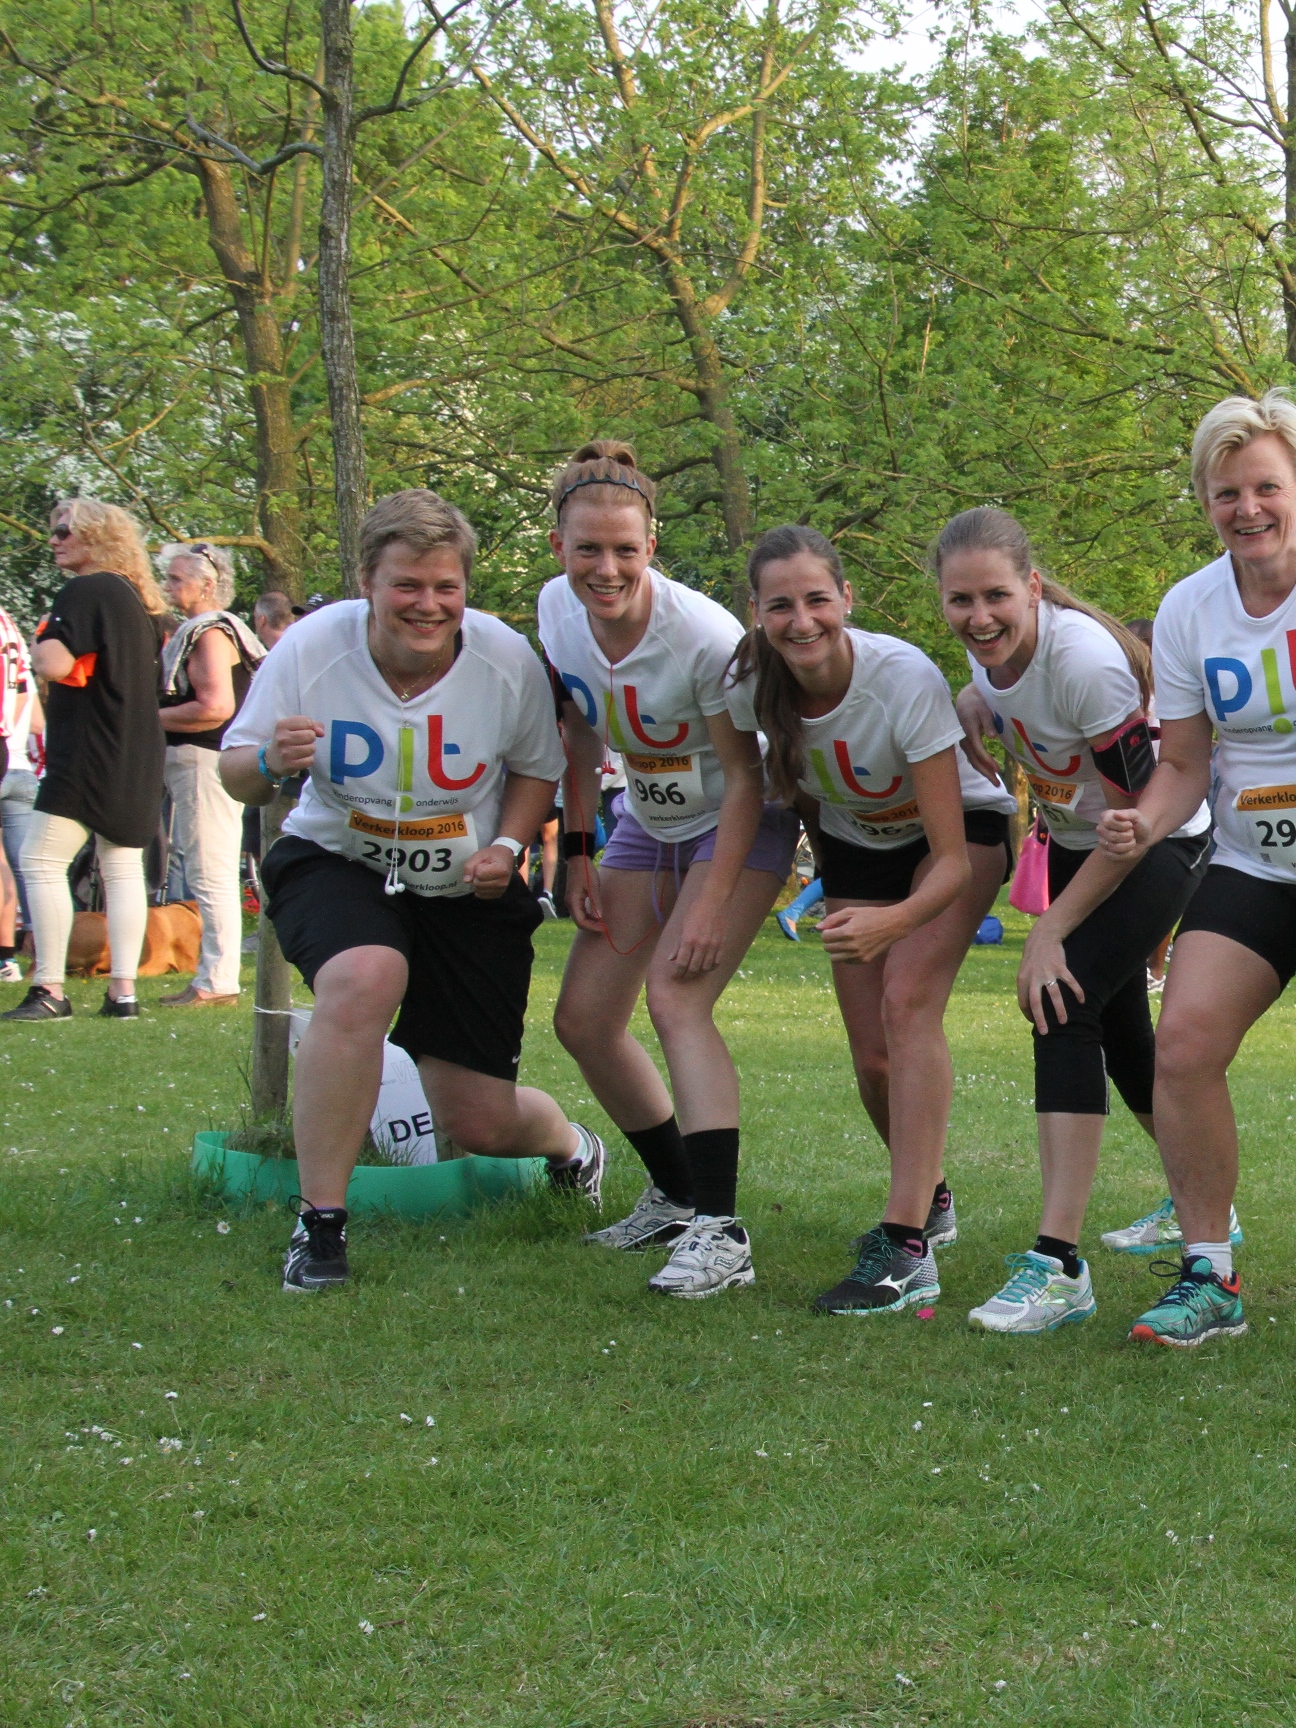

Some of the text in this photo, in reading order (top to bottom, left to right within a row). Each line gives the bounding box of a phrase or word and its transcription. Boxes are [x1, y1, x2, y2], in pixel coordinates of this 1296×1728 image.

[660, 755, 689, 768] 2016
[634, 779, 686, 806] 966
[1044, 784, 1073, 799] 2016
[416, 797, 459, 807] onderwijs
[353, 815, 465, 838] Verkerkloop 2016
[361, 840, 453, 873] 2903
